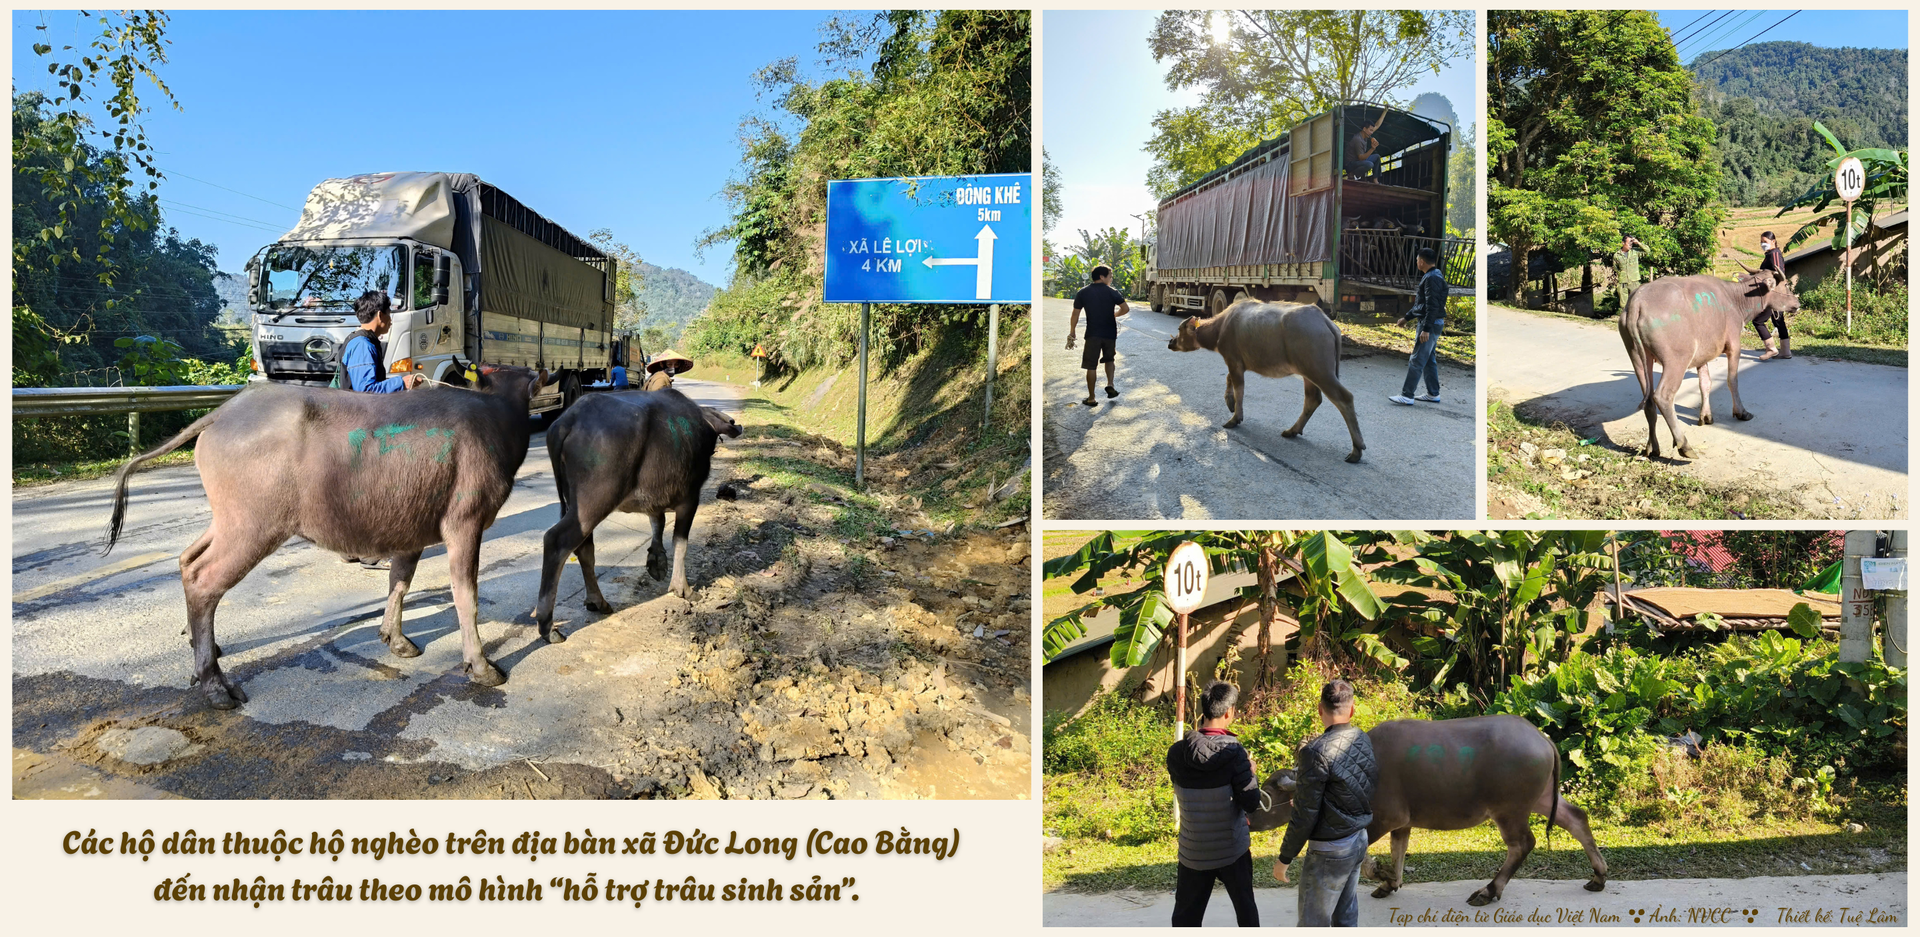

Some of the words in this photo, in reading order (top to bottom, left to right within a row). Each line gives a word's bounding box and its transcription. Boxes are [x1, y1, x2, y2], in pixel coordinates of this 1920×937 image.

[1841, 168, 1861, 190] 10t
[956, 184, 991, 205] ĐÔNG
[995, 182, 1021, 204] KHÊ
[978, 208, 1001, 221] 5km
[849, 238, 869, 254] XÃ
[873, 237, 892, 254] LÊ
[896, 238, 922, 257] LỢI
[861, 259, 871, 272] 4
[876, 258, 902, 273] KM
[1174, 560, 1202, 597] 10t
